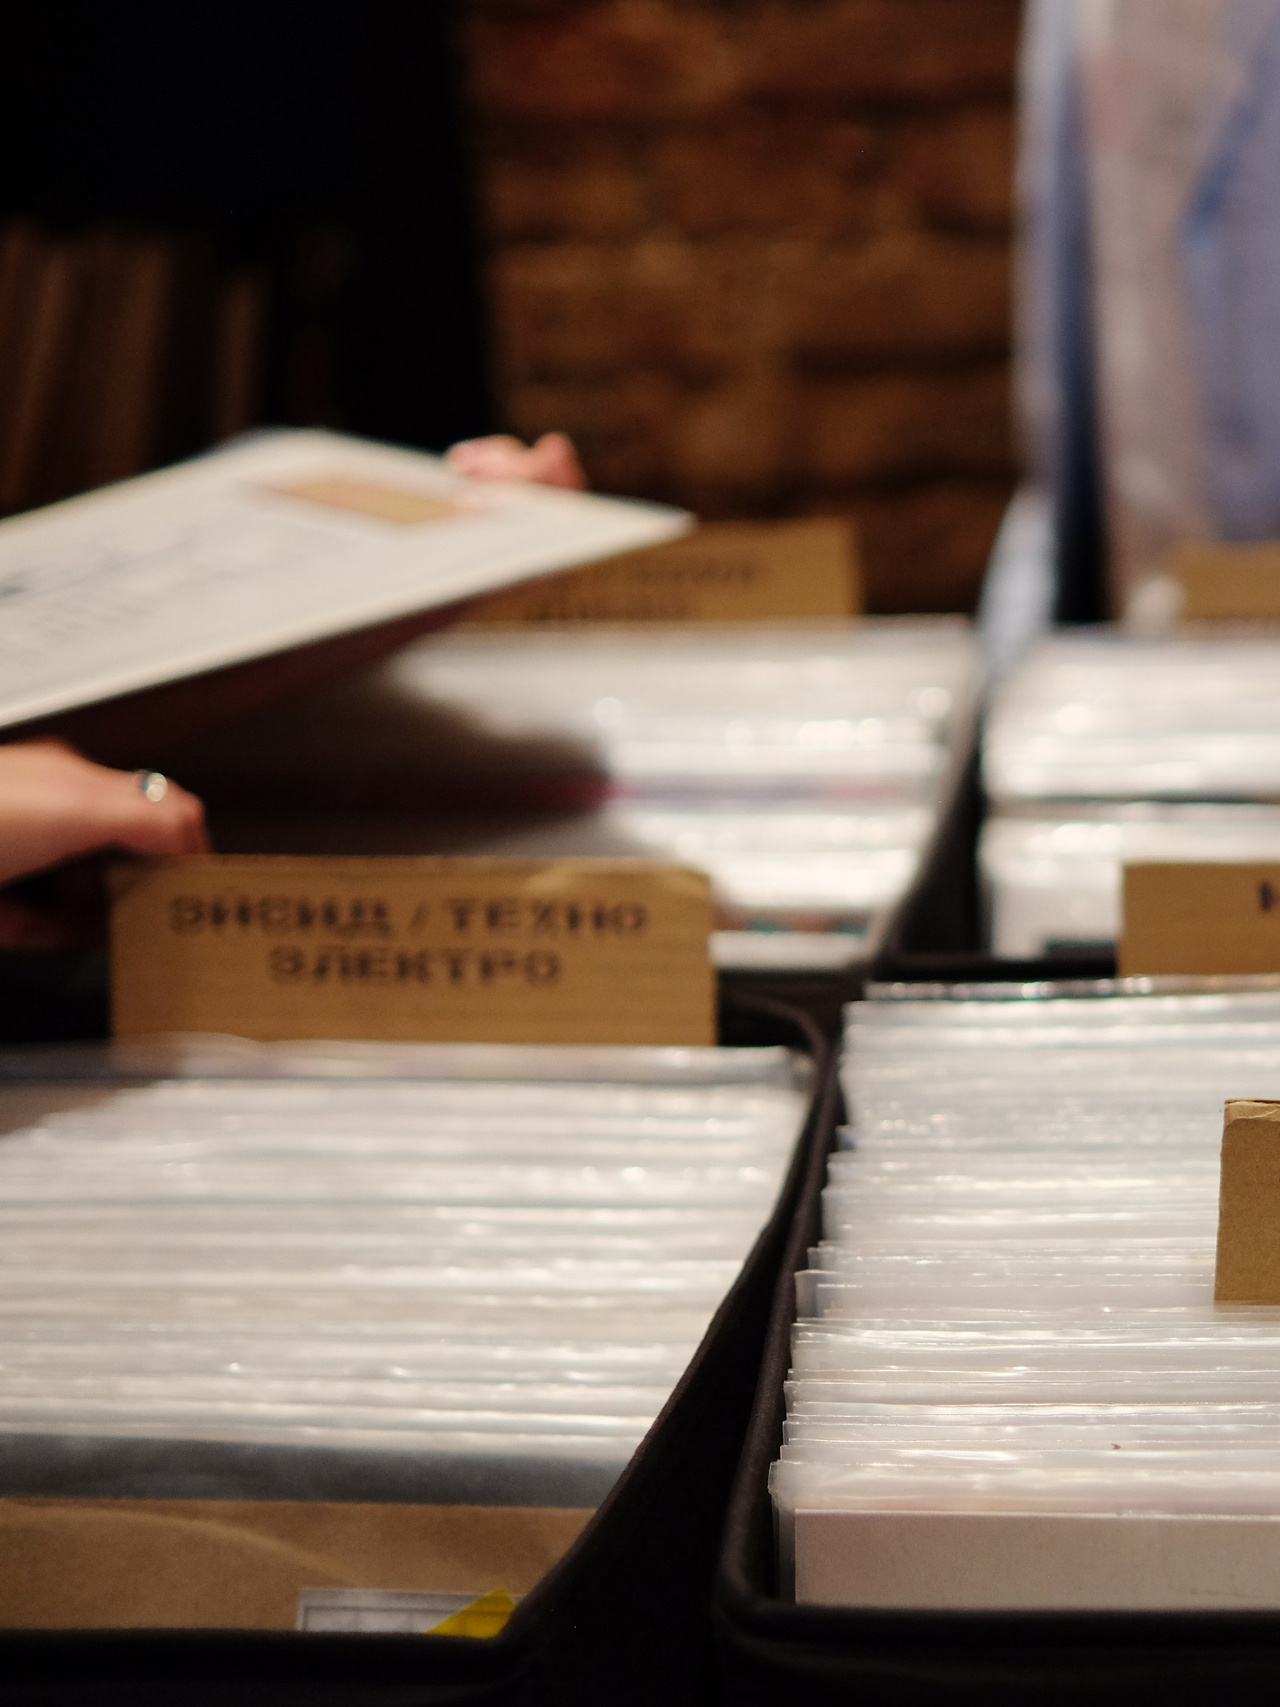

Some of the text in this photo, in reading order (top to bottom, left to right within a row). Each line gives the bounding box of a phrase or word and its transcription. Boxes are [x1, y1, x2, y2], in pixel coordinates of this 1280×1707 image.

[170, 887, 650, 939] ЭЙСИД / ТЕХНО
[268, 944, 563, 986] ЭЛЕКТРО
